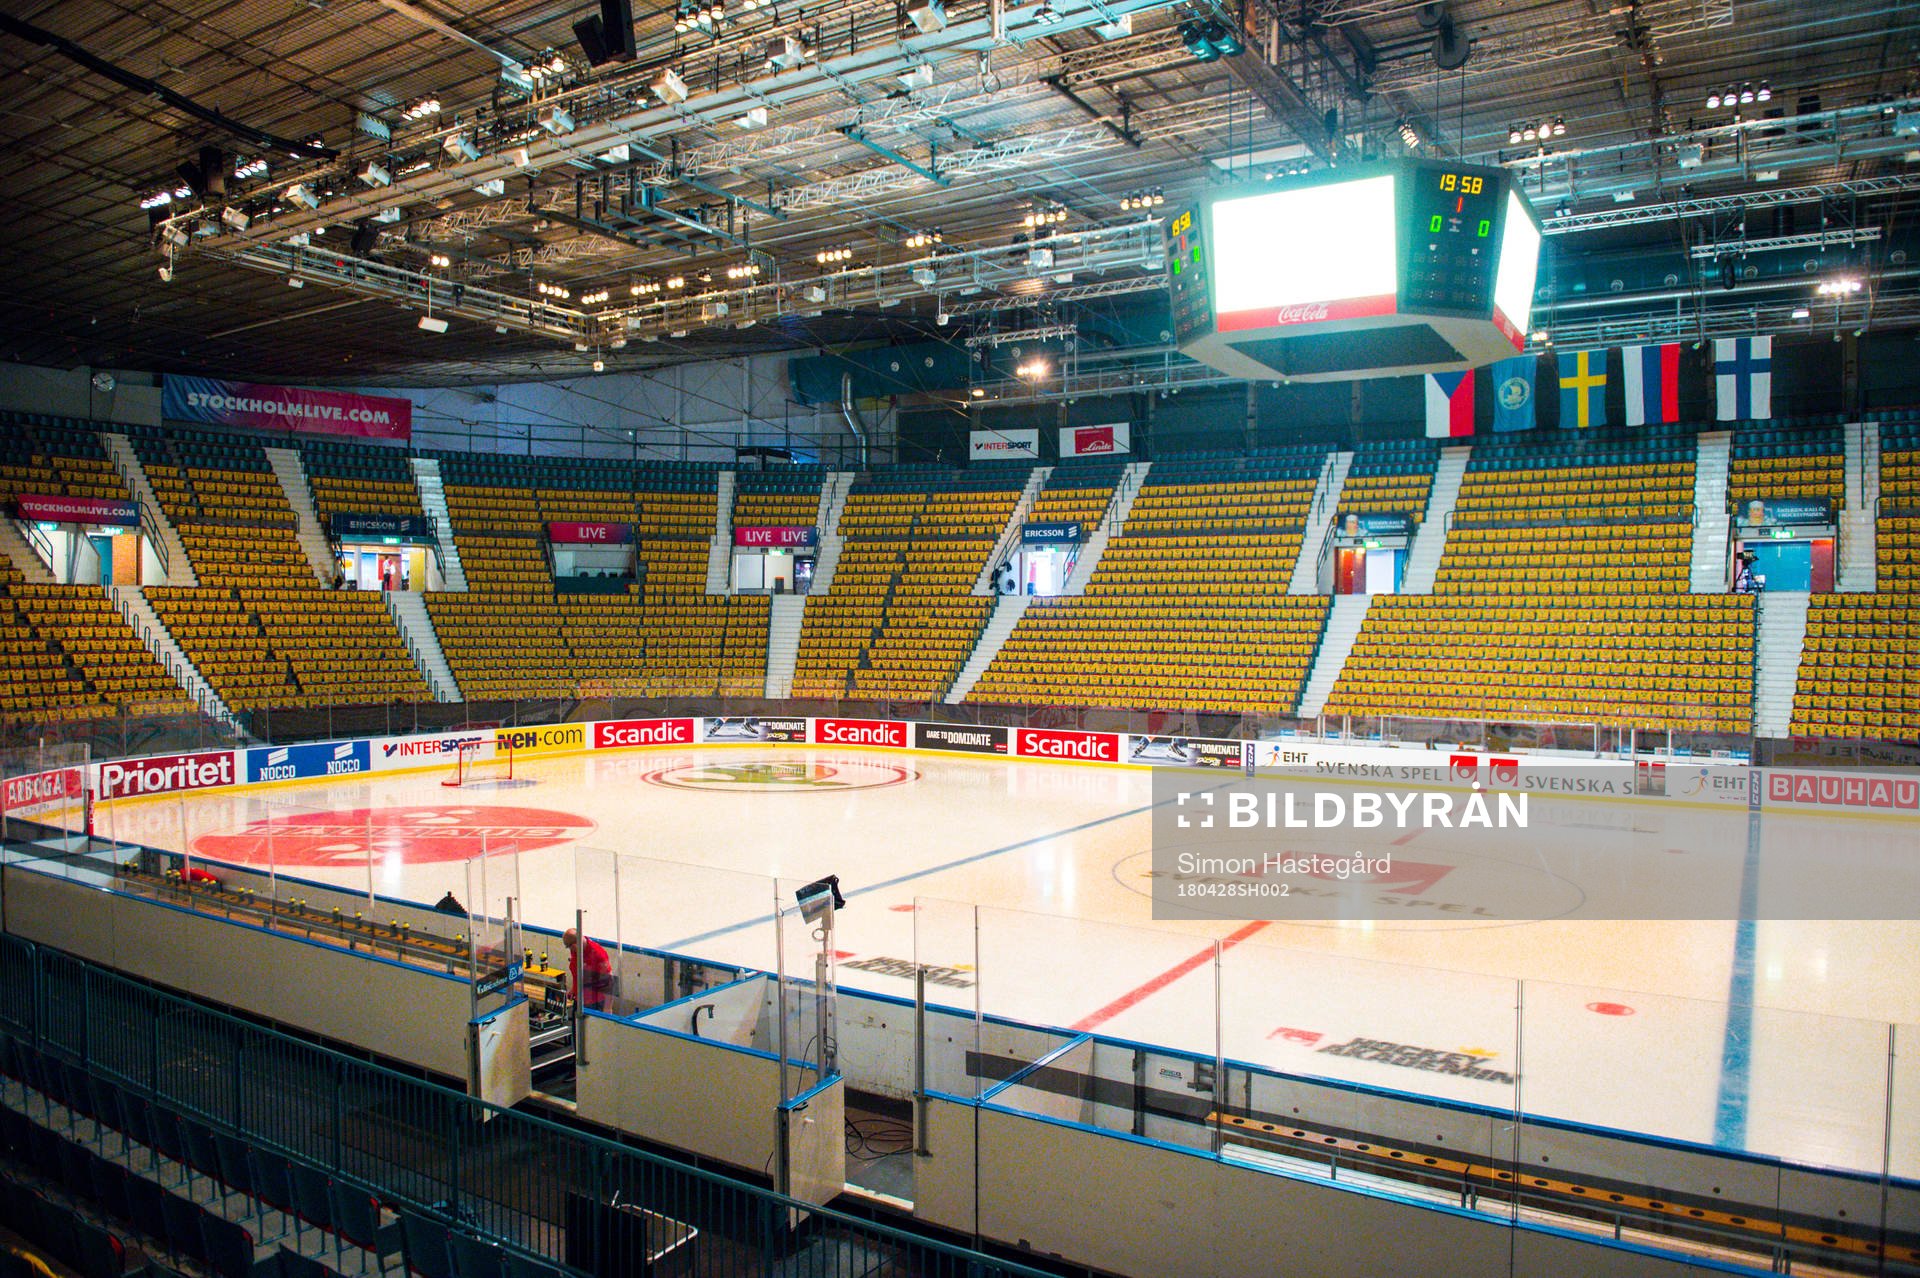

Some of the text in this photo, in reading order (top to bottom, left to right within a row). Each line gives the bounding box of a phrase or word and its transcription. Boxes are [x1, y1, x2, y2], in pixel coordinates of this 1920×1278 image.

[1440, 174, 1483, 195] 19:58
[1429, 214, 1443, 233] 0
[1477, 219, 1490, 237] 0
[187, 391, 391, 425] STOCKHOLMLIVE.COM
[983, 440, 1033, 451] INTERSPORT
[1081, 439, 1112, 452] Linde
[21, 502, 136, 517] STOCKHOLMLIVE.COM
[349, 520, 396, 530] ERICSSON
[579, 527, 607, 539] LIVE
[1024, 528, 1065, 538] ERICSSON
[745, 530, 808, 542] LIVE LIVE
[602, 721, 685, 745] Scandic
[771, 721, 805, 731] DOMINATE
[823, 722, 900, 745] Scandic
[400, 736, 482, 757] INTERSPORT
[926, 730, 991, 747] DARE TO DOMINATE
[1025, 733, 1110, 759] Scandic
[1201, 743, 1240, 756] DOMINATE
[260, 764, 296, 782] NOCCO
[326, 758, 360, 775] NOCCO
[1316, 760, 1443, 781] SVENSKA SPEL
[102, 755, 232, 798] Prioritet
[1525, 775, 1615, 794] SVENSKA
[8, 773, 63, 806] ARBOGA
[1771, 776, 1917, 807] BAUHAU
[1373, 896, 1498, 917] SPEL
